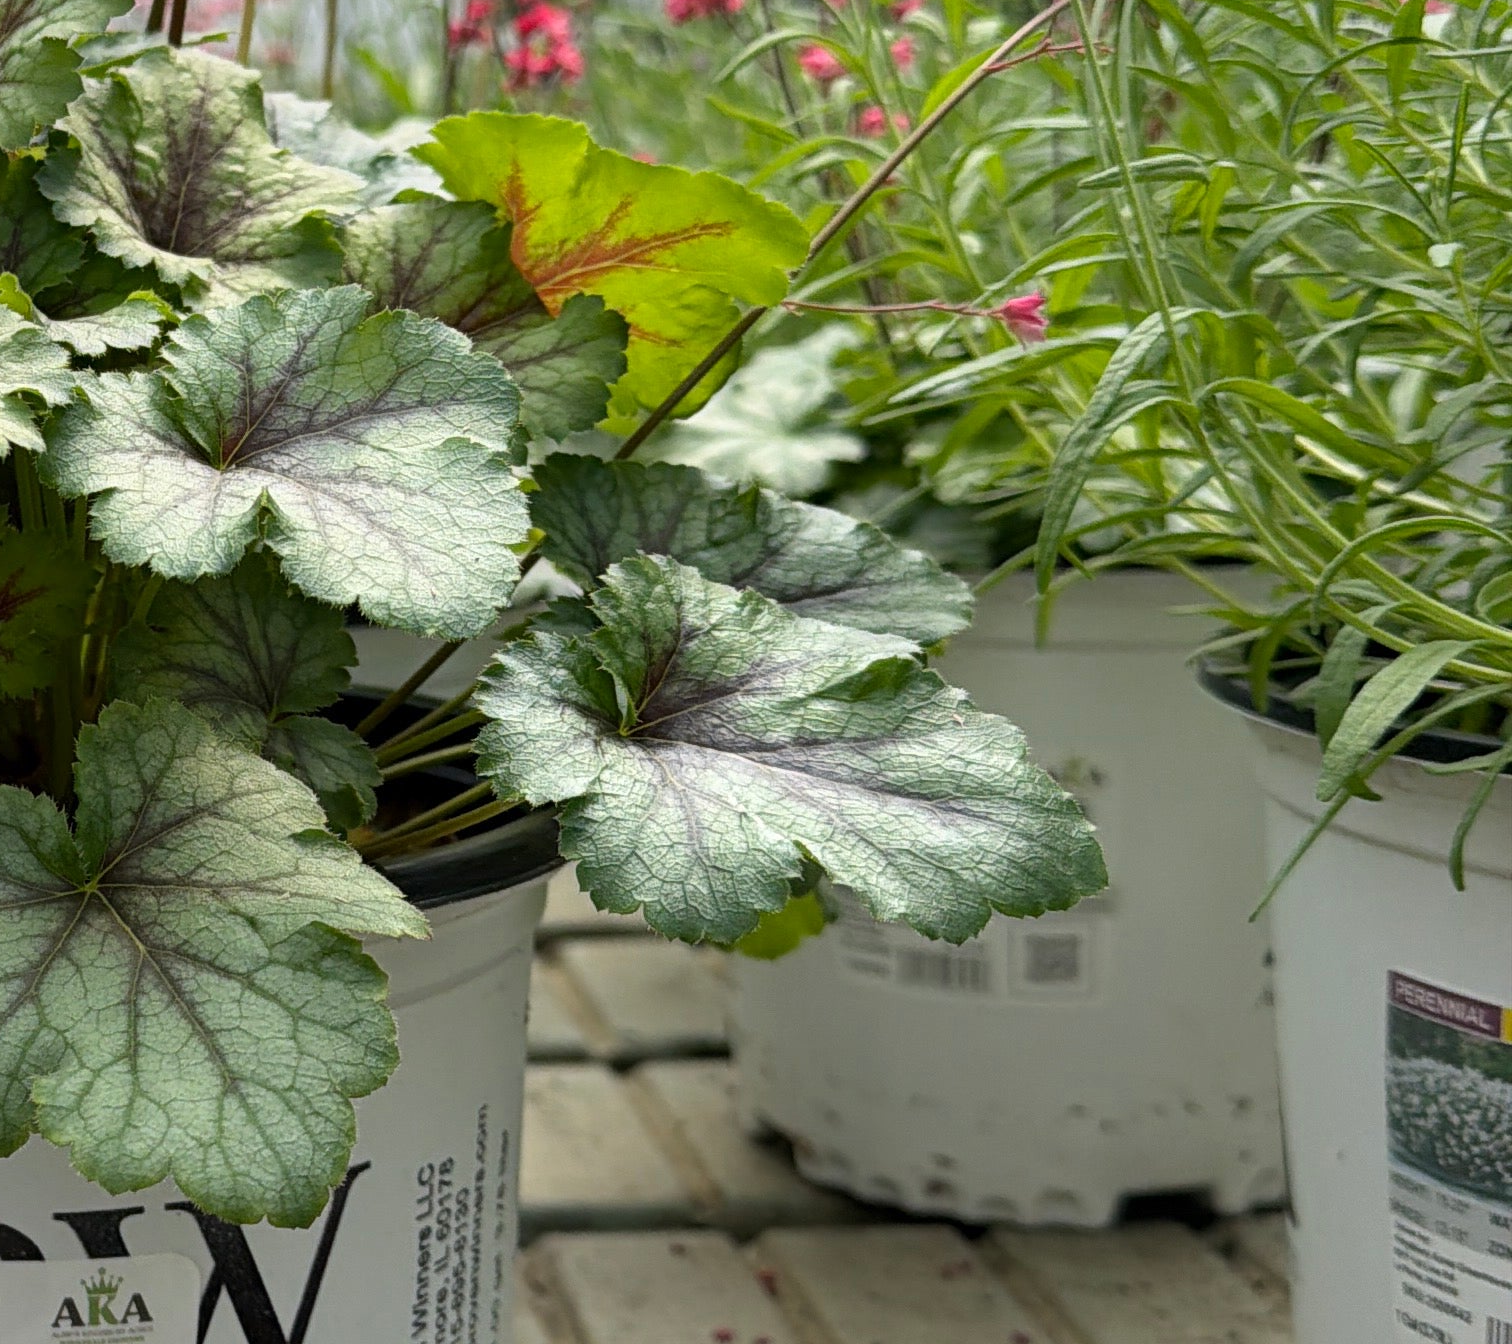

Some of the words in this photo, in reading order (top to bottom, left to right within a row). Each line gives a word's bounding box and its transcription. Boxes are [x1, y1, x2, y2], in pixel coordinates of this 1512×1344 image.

[416, 1162, 435, 1222] LLC
[411, 1225, 433, 1339] Winners
[434, 1244, 450, 1273] IL
[51, 1292, 154, 1328] AKA
